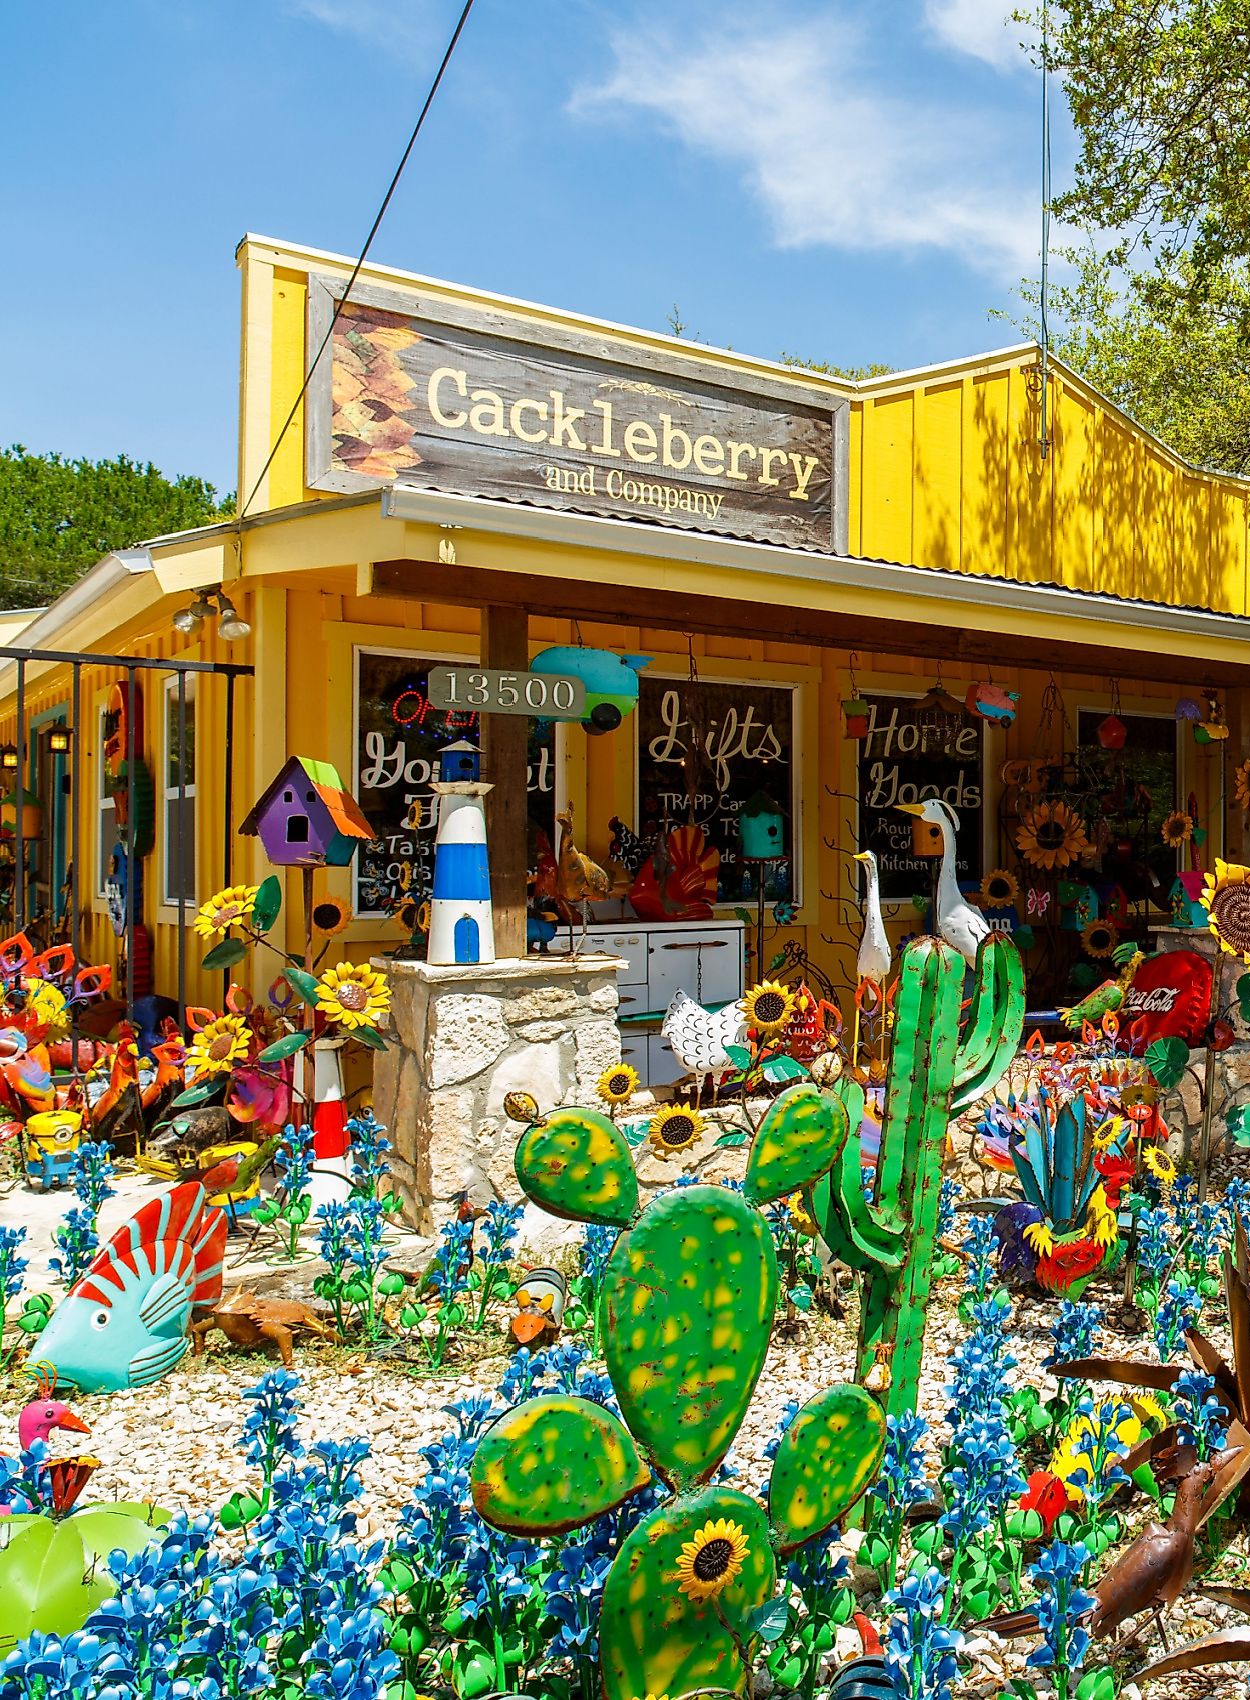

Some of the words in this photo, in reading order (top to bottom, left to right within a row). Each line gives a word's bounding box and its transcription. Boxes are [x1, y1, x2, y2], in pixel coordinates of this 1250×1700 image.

[427, 367, 819, 501] Cackleberry
[546, 465, 597, 496] and
[606, 469, 725, 521] Company
[444, 672, 575, 710] 13500
[648, 690, 789, 792] Gifts
[657, 792, 714, 811] TRAPP
[868, 761, 981, 809] Goods
[879, 853, 929, 871] Kitchen
